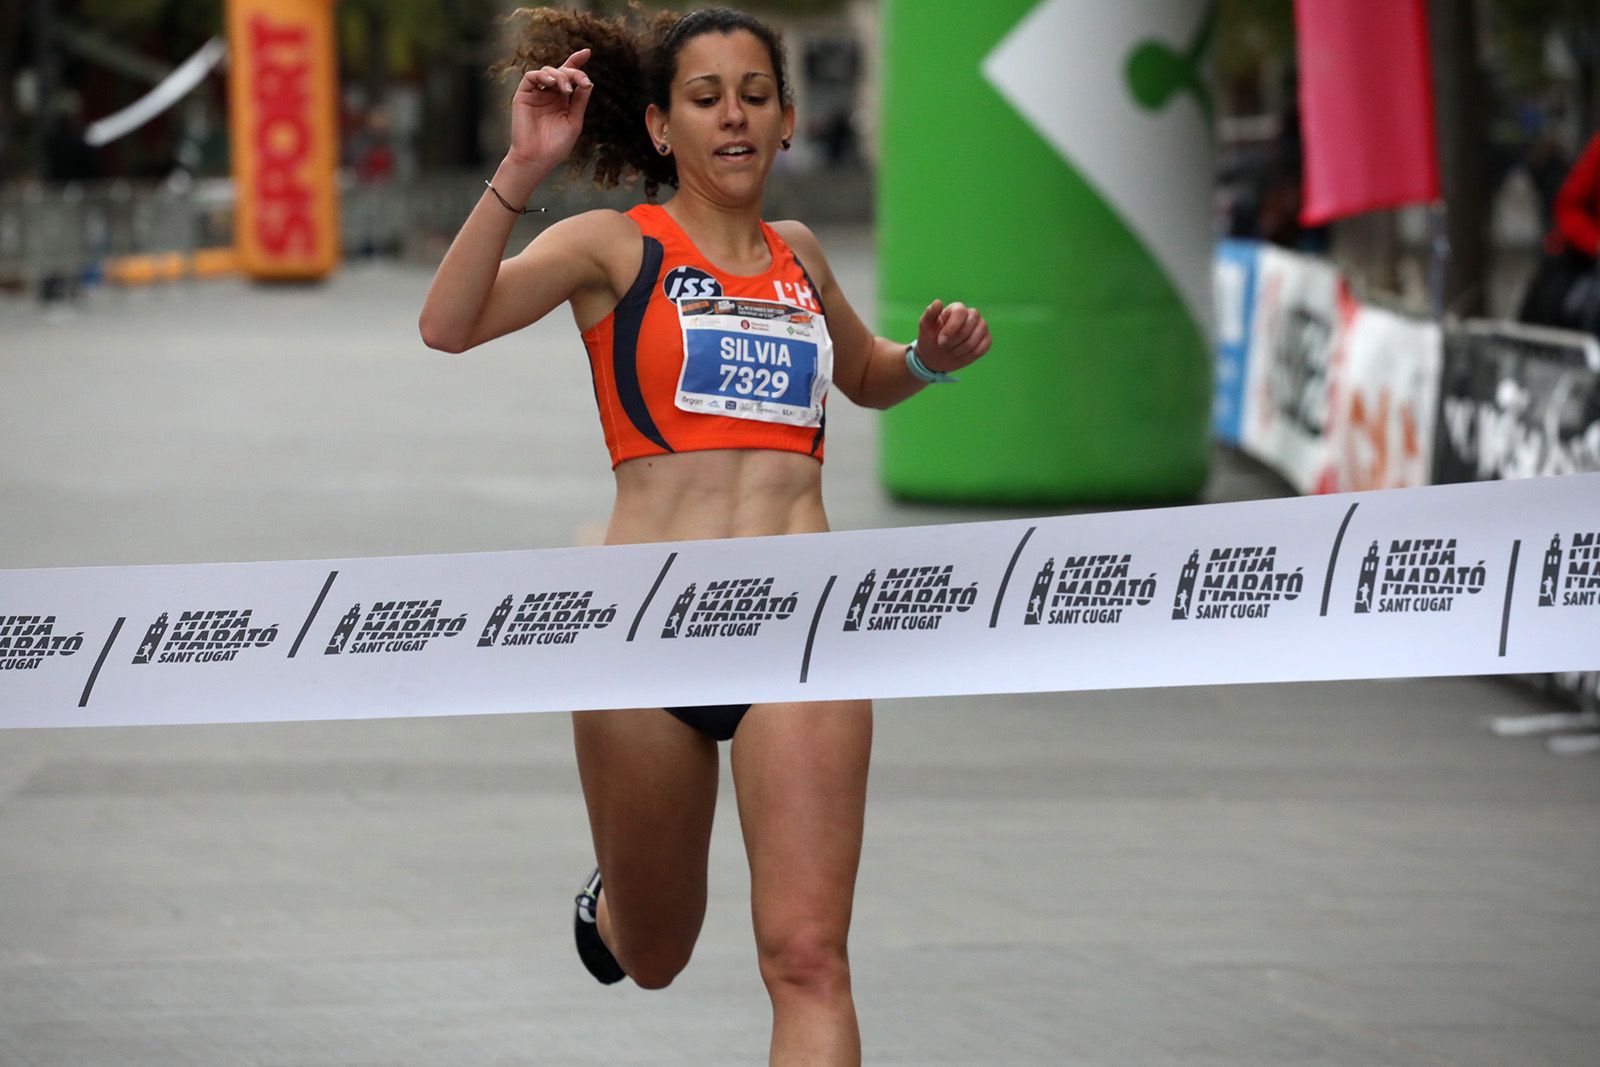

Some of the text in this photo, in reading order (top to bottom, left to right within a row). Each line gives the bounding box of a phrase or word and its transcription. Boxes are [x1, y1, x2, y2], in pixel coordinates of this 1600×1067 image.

[249, 15, 318, 260] SPORT
[719, 337, 792, 368] SILVIA
[718, 364, 790, 399] 7329
[1205, 546, 1277, 573] MITJA
[1386, 539, 1457, 566] MITJA
[881, 565, 954, 589] MITJA
[1060, 554, 1132, 580] MITJA
[1380, 560, 1486, 595] MARATÓ
[700, 577, 775, 600] MITJA
[1051, 573, 1157, 608] MARATÓ
[1199, 567, 1304, 602] MARATÓ
[518, 591, 594, 612] MITJA
[690, 592, 799, 623] MARATÓ
[871, 581, 979, 614] MARATÓ
[1378, 597, 1454, 613] SANT CUGAT
[1562, 591, 1597, 606] SANT
[174, 610, 253, 631] MITJA
[365, 599, 443, 622] MITJA
[507, 603, 618, 632] MARATÓ
[1048, 609, 1123, 625] SANT CUGAT
[1196, 603, 1271, 619] SANT CUGAT
[355, 613, 469, 642] MARATÓ
[685, 622, 762, 638] SANT CUGAT
[867, 615, 943, 631] SANT CUGAT
[164, 624, 279, 653] MARATÓ
[349, 640, 429, 654] SANT CUGAT
[501, 632, 579, 646] SANT CUGAT
[0, 658, 43, 670] CUGAT
[158, 650, 240, 664] SANT CUGAT
